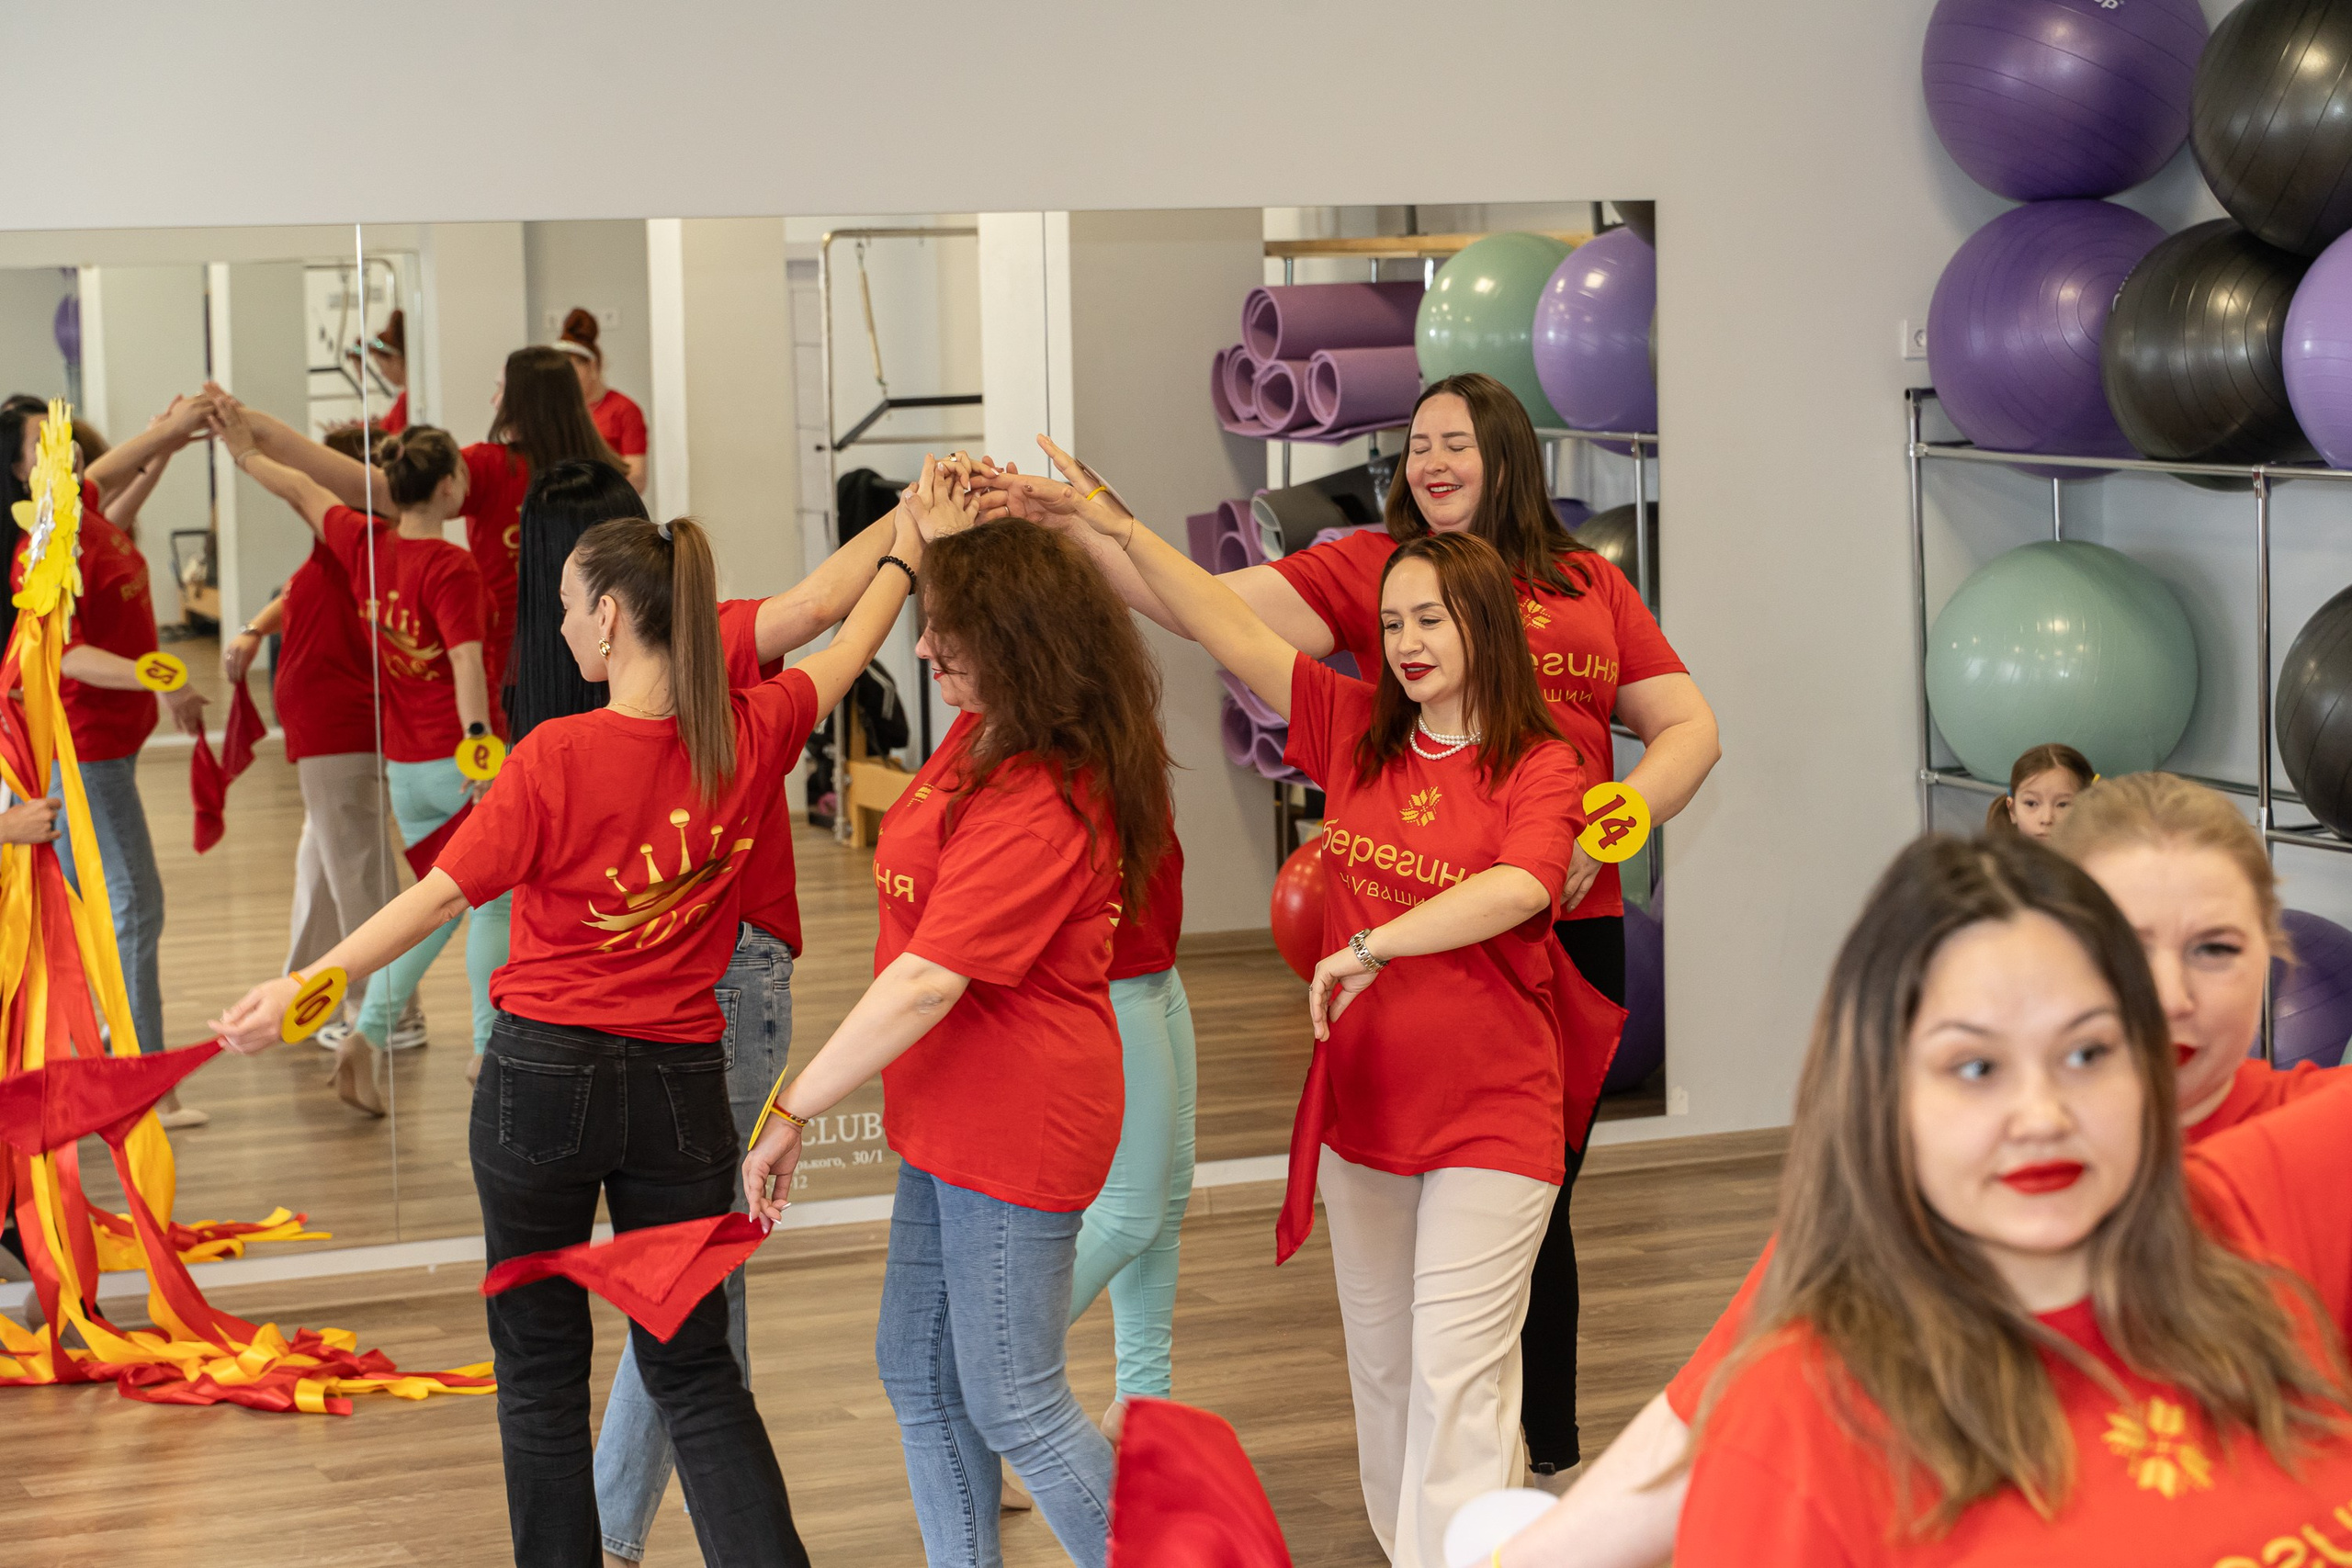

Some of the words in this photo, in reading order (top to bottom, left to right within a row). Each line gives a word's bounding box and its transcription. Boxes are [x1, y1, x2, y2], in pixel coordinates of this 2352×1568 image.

[1586, 794, 1637, 850] 14
[1321, 818, 1478, 888] берегин
[1339, 872, 1426, 908] чуваши
[294, 977, 334, 1026] 10
[795, 1157, 846, 1174] рького,
[852, 1149, 883, 1166] 30/1
